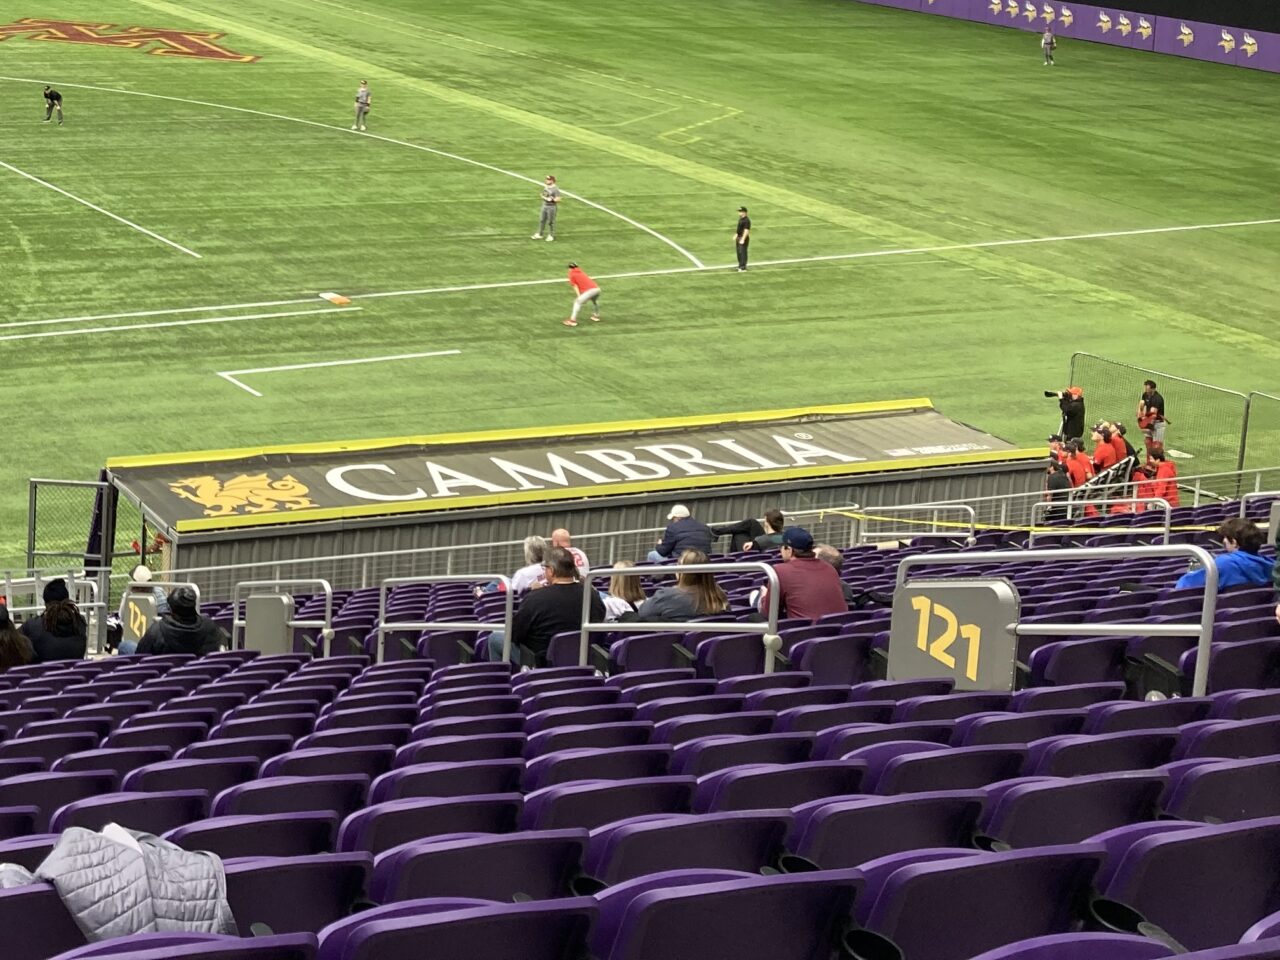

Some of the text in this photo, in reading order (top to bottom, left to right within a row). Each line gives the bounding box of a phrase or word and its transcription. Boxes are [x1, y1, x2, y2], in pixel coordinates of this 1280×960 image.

[324, 434, 867, 501] CAMBRIA
[128, 601, 147, 638] 121
[911, 595, 982, 682] 121
